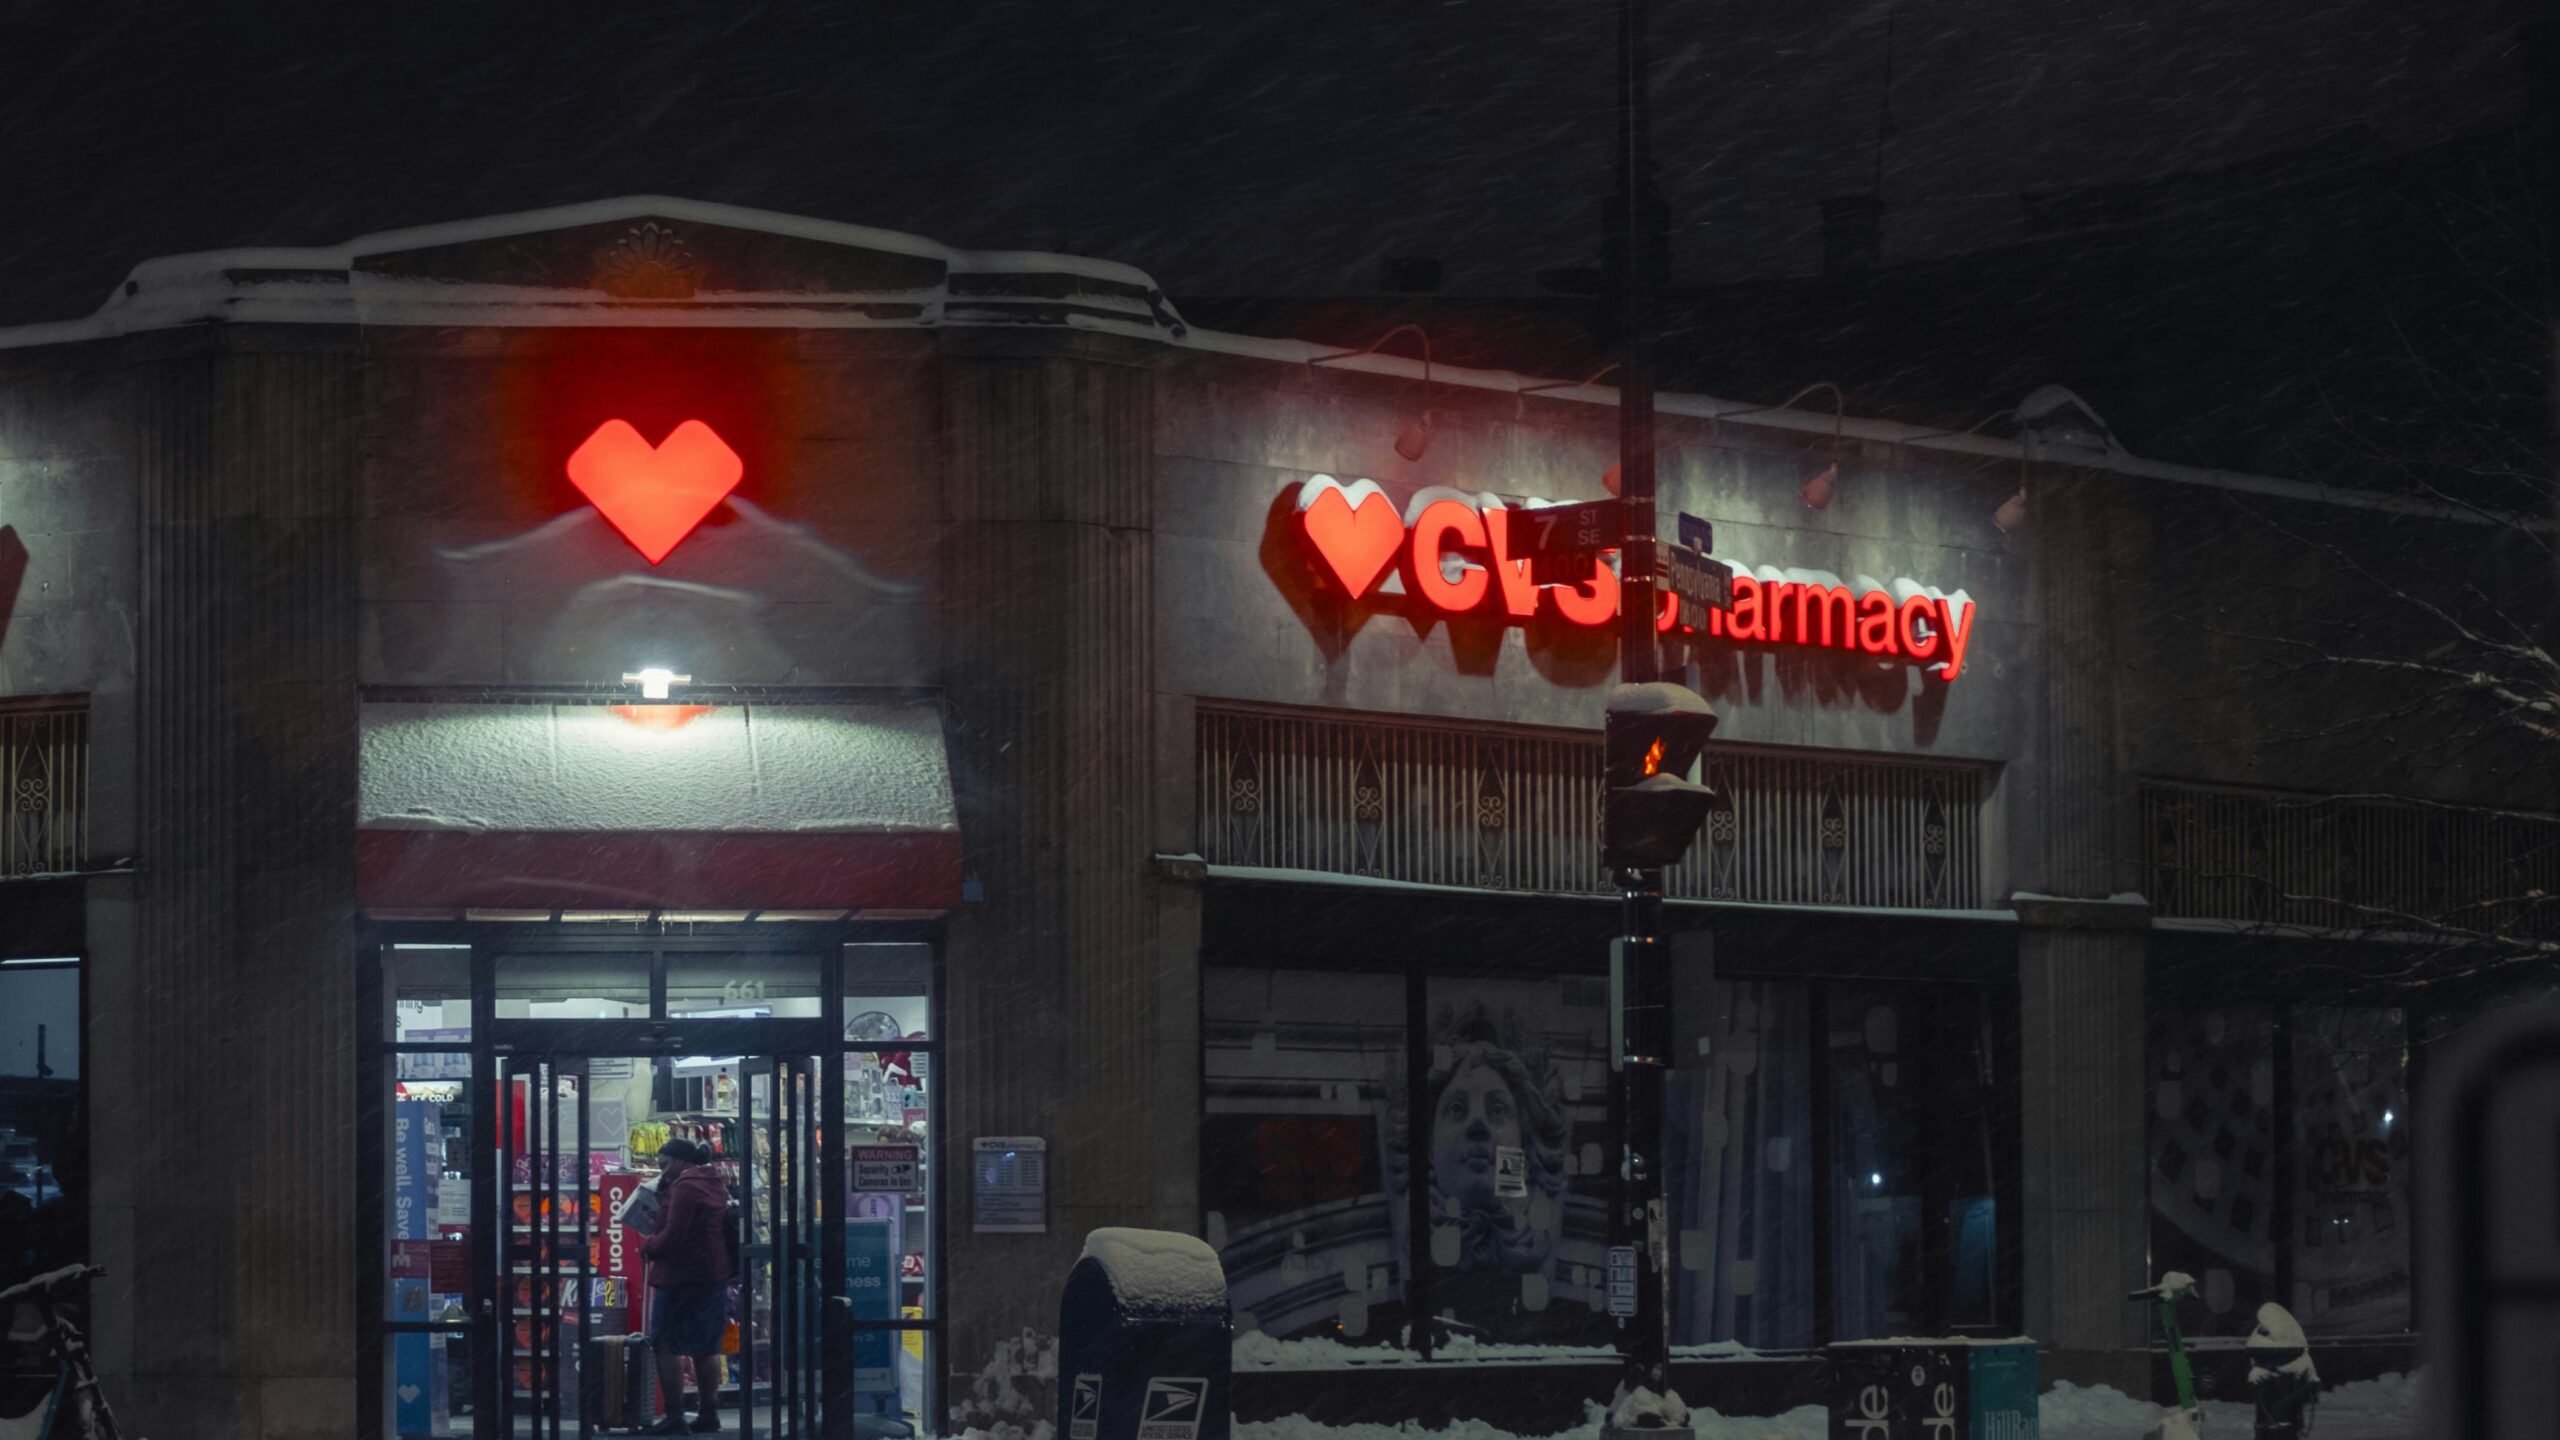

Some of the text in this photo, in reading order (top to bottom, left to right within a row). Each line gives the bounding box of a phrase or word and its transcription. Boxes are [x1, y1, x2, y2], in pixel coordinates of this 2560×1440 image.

[1532, 508, 1598, 551] 7 ST
[1578, 528, 1601, 546] SE
[1656, 576, 1976, 682] armacy
[724, 979, 765, 1001] 661
[428, 1094, 454, 1103] COLD
[395, 1117, 410, 1143] Be
[395, 1147, 412, 1192] well.
[857, 1150, 913, 1161] WARNING
[2313, 1138, 2390, 1186] CVS
[395, 1196, 412, 1240] Save
[606, 1186, 623, 1272] coupon
